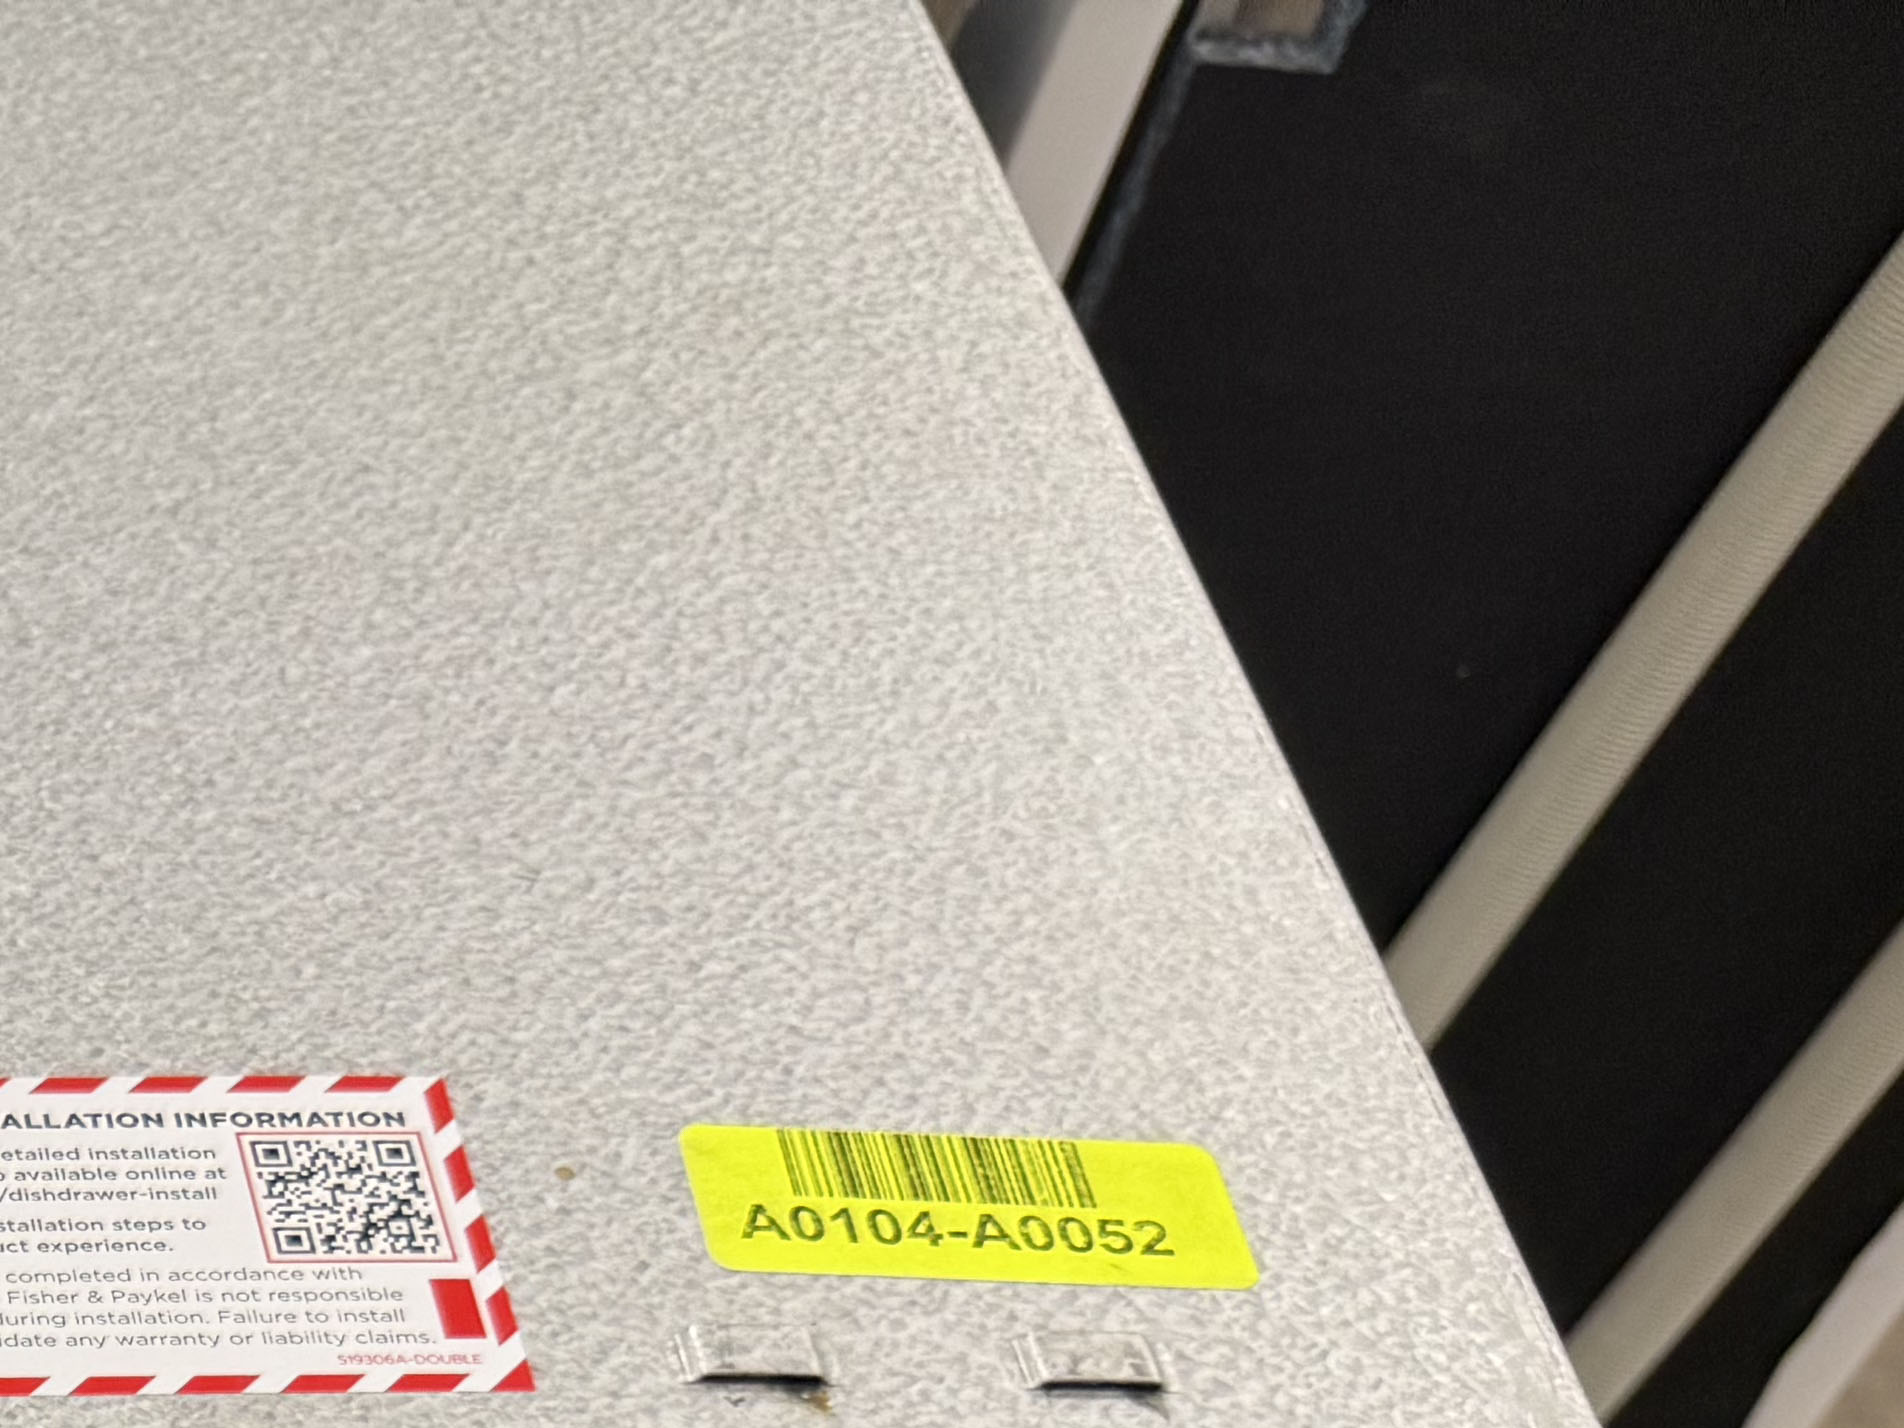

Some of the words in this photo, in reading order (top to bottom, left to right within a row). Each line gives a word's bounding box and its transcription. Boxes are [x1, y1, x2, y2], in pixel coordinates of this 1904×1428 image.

[174, 1111, 406, 1130] INFORMATION
[89, 1147, 217, 1161] installation
[14, 1167, 120, 1181] available
[125, 1167, 196, 1181] online
[204, 1168, 227, 1180] at
[112, 1218, 175, 1234] steps
[183, 1218, 207, 1231] to
[740, 1203, 1176, 1258] A0104-A0052
[37, 1238, 174, 1255] experience.
[5, 1268, 131, 1286] completed
[140, 1267, 160, 1282] in
[167, 1267, 304, 1282] accordance
[312, 1266, 362, 1281] with
[7, 1290, 78, 1305] Fisher
[88, 1289, 104, 1303] &
[111, 1289, 187, 1306] Paykel
[194, 1289, 213, 1302] is
[221, 1289, 261, 1302] not
[268, 1287, 405, 1304] responsible
[75, 1310, 210, 1326] installation.
[218, 1309, 297, 1324] Failure
[305, 1310, 329, 1323] to
[336, 1308, 406, 1323] install
[65, 1333, 110, 1348] any
[115, 1332, 221, 1348] warranty
[229, 1332, 255, 1346] or
[263, 1330, 346, 1347] liability
[356, 1330, 437, 1345] claims.
